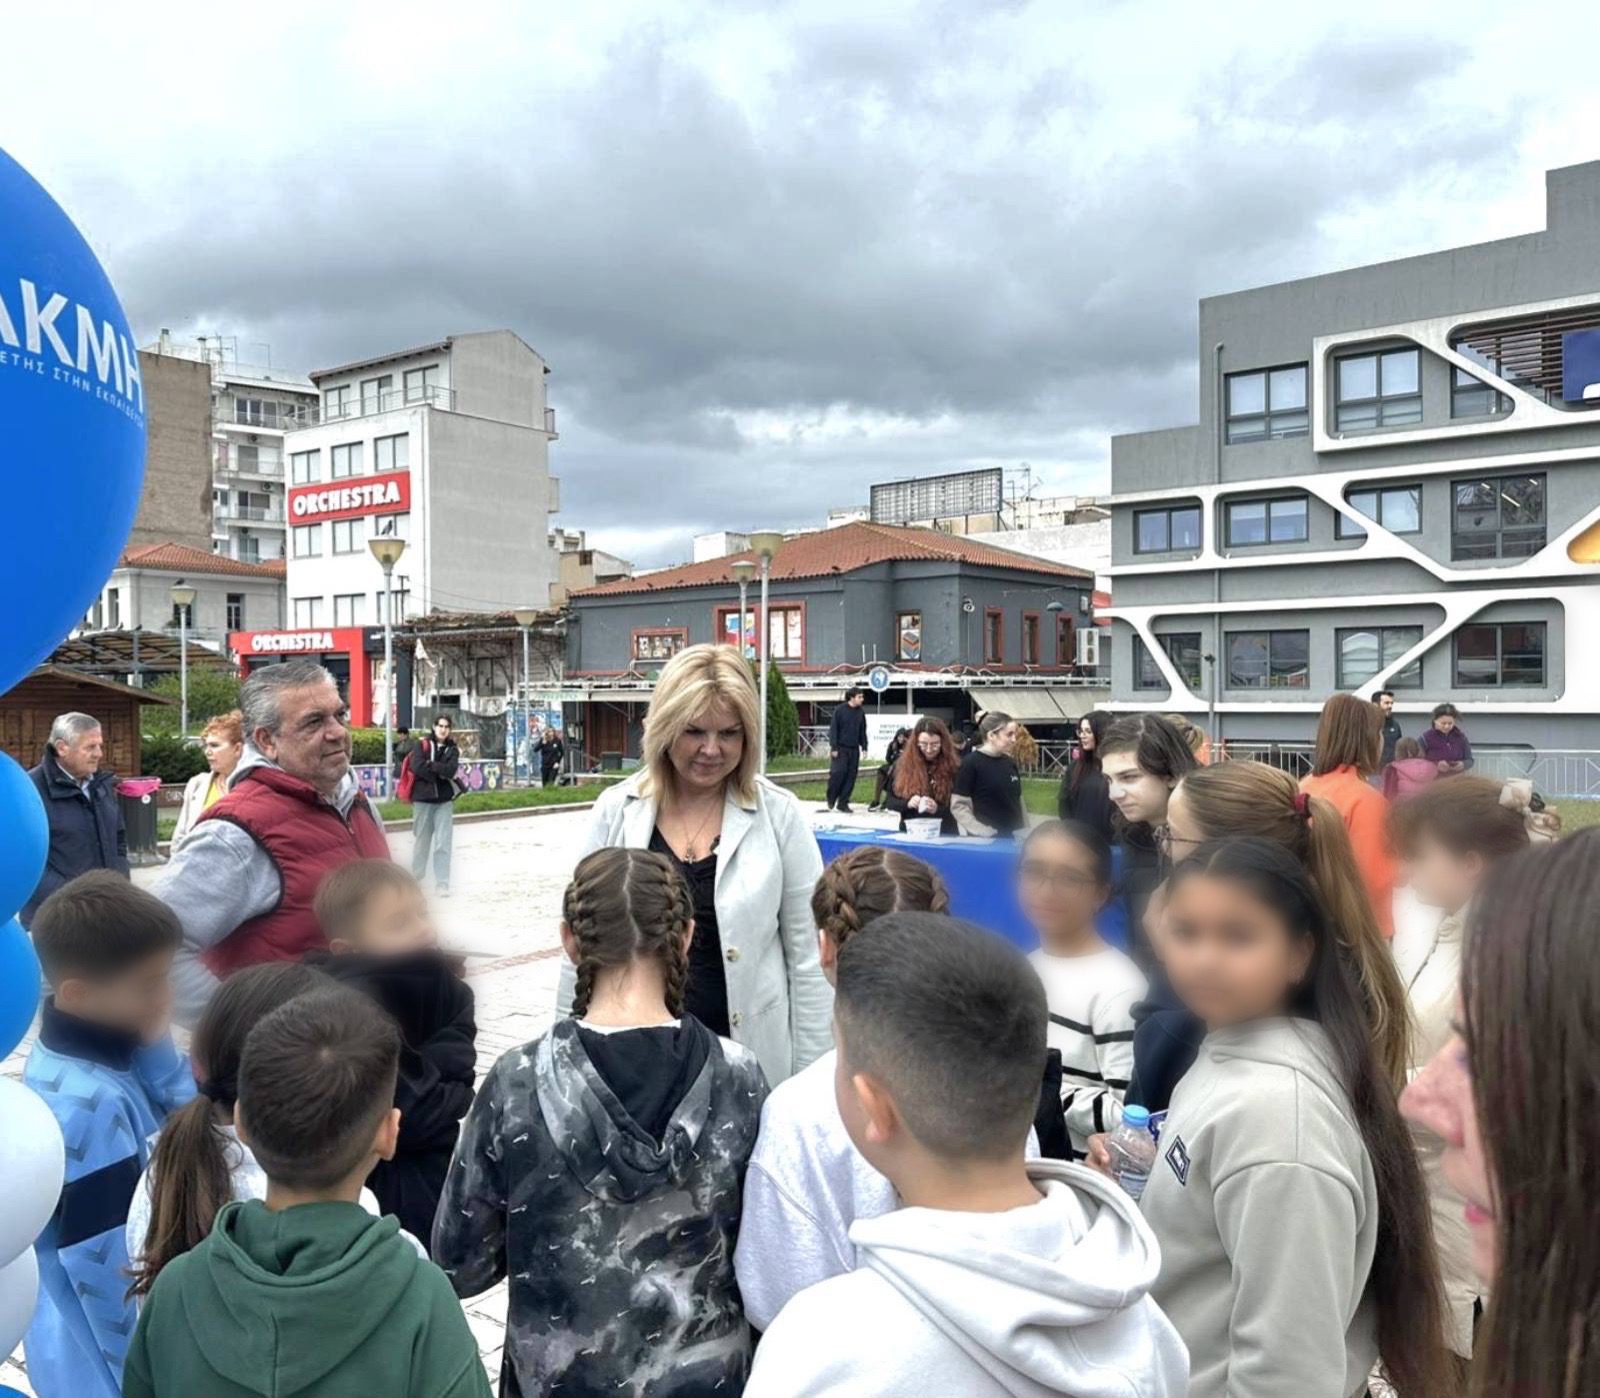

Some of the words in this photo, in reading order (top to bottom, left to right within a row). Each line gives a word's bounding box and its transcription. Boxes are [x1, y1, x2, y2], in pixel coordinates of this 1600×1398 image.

[53, 367, 90, 392] ΣΤΗΝ
[293, 481, 400, 516] ORCHESTRA
[251, 632, 334, 650] ORCHESTRA
